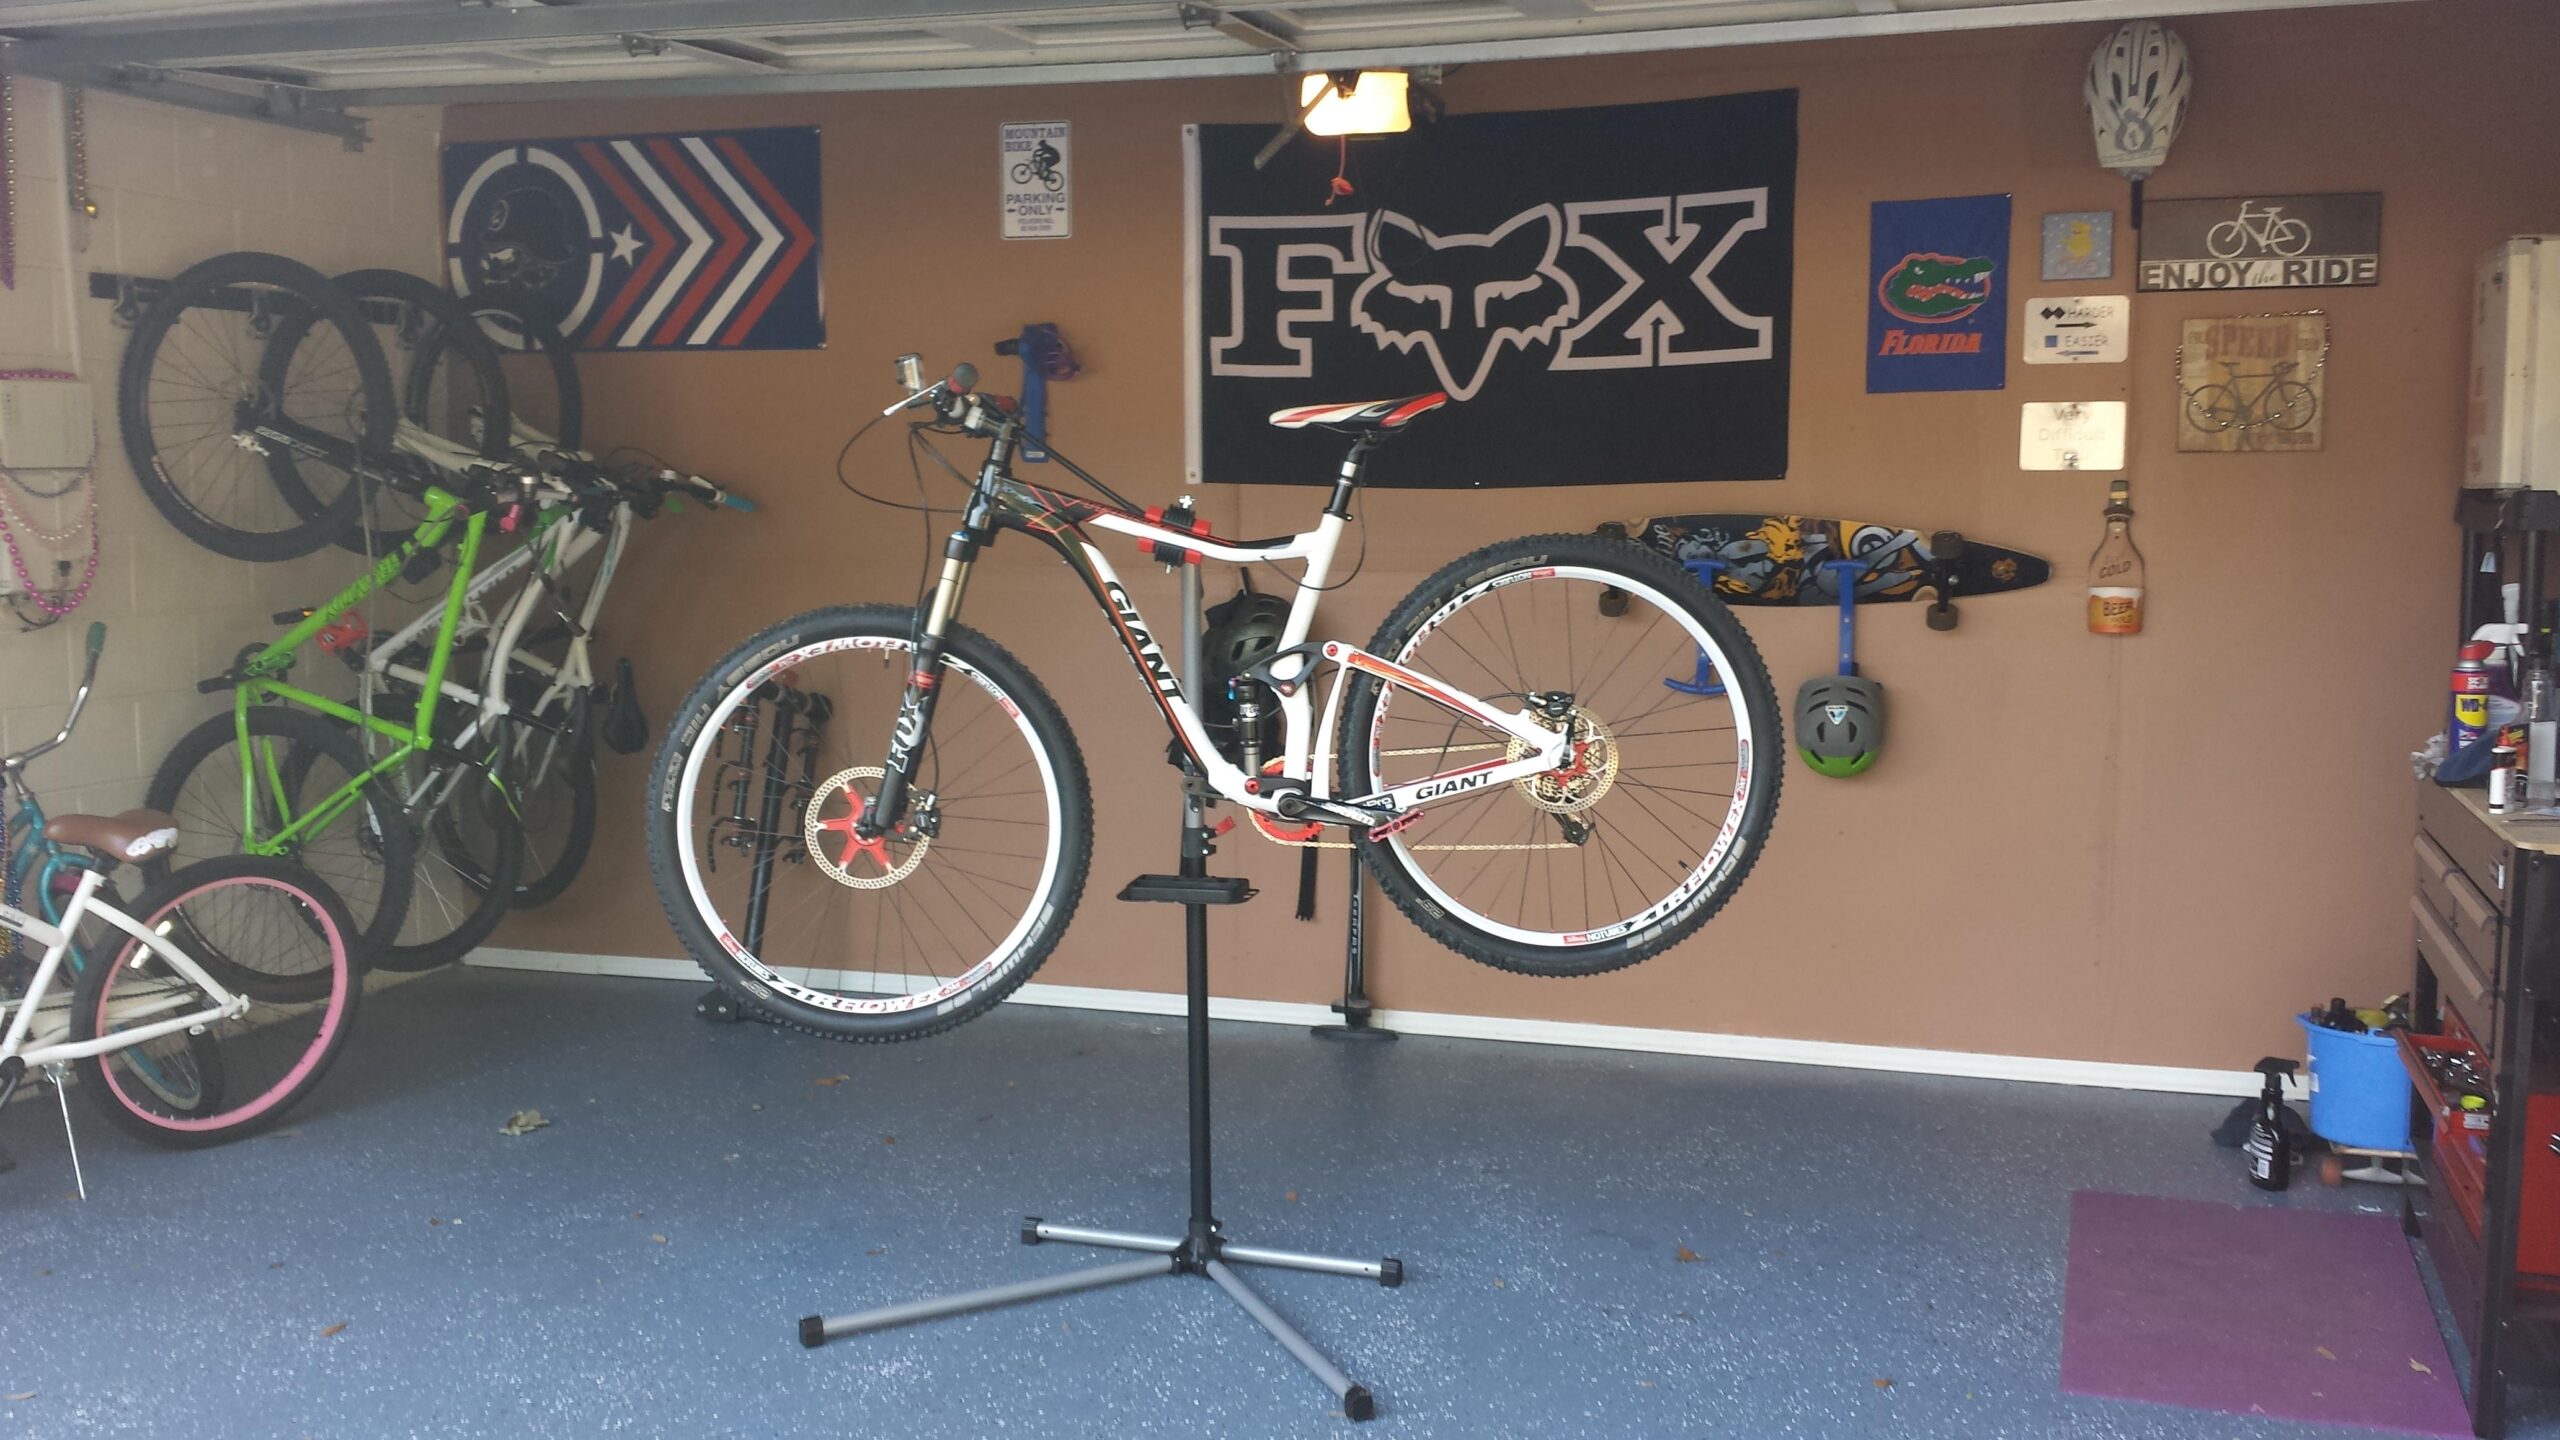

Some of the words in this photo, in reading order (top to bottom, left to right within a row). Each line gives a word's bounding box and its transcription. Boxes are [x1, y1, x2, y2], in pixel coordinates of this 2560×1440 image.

[1004, 127, 1065, 139] MOUNTAIN
[1005, 141, 1032, 152] BIKE
[1006, 193, 1065, 204] PARKING
[1019, 205, 1053, 216] ONLY
[2142, 261, 2254, 290] ENJOY
[2252, 261, 2277, 284] the
[2283, 258, 2375, 285] RIDE
[1209, 187, 1773, 400] FOX
[2066, 305, 2115, 319] HARDER
[2065, 334, 2109, 347] EASIER
[2053, 407, 2091, 424] Very
[2099, 560, 2132, 579] COLD
[2103, 599, 2134, 617] BEER
[1104, 581, 1188, 703] GIANT
[886, 690, 930, 774] FOX
[1416, 770, 1494, 800] GIANT
